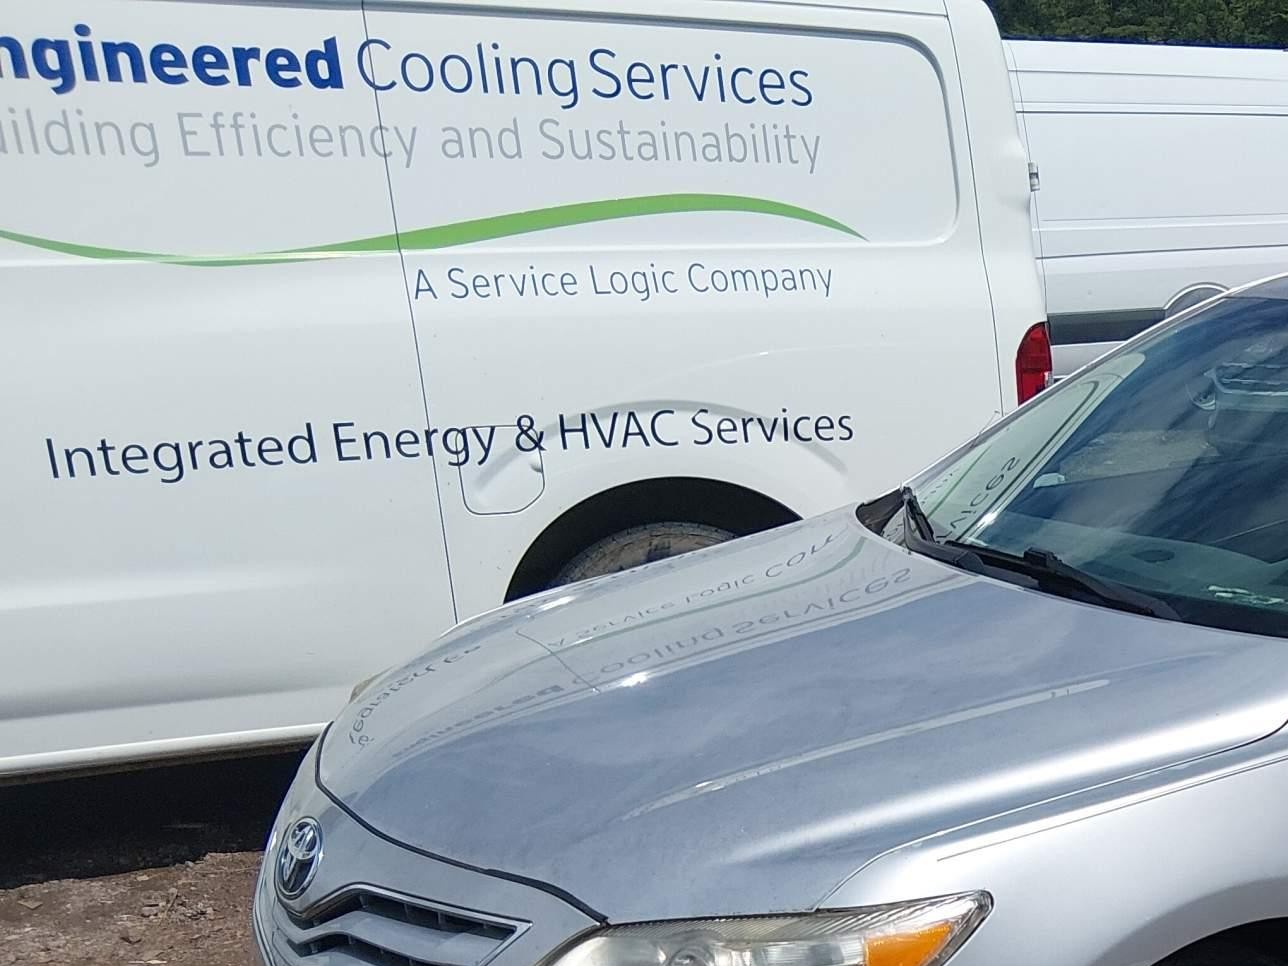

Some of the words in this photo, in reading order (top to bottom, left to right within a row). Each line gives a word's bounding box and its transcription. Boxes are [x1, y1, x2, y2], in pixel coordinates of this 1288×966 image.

[357, 38, 579, 110] Cooling
[588, 48, 814, 107] Services
[0, 107, 160, 168] ilding
[177, 111, 418, 169] Efficiency
[441, 117, 523, 160] and
[538, 117, 821, 175] Sustainability
[413, 269, 438, 300] A
[447, 265, 578, 299] Service
[589, 263, 678, 301] Logic
[688, 262, 832, 299] Company
[45, 421, 319, 484] Integrated
[331, 420, 497, 467] Energy
[515, 414, 547, 453] &
[558, 409, 680, 450] HVAC
[691, 407, 854, 445] Services
